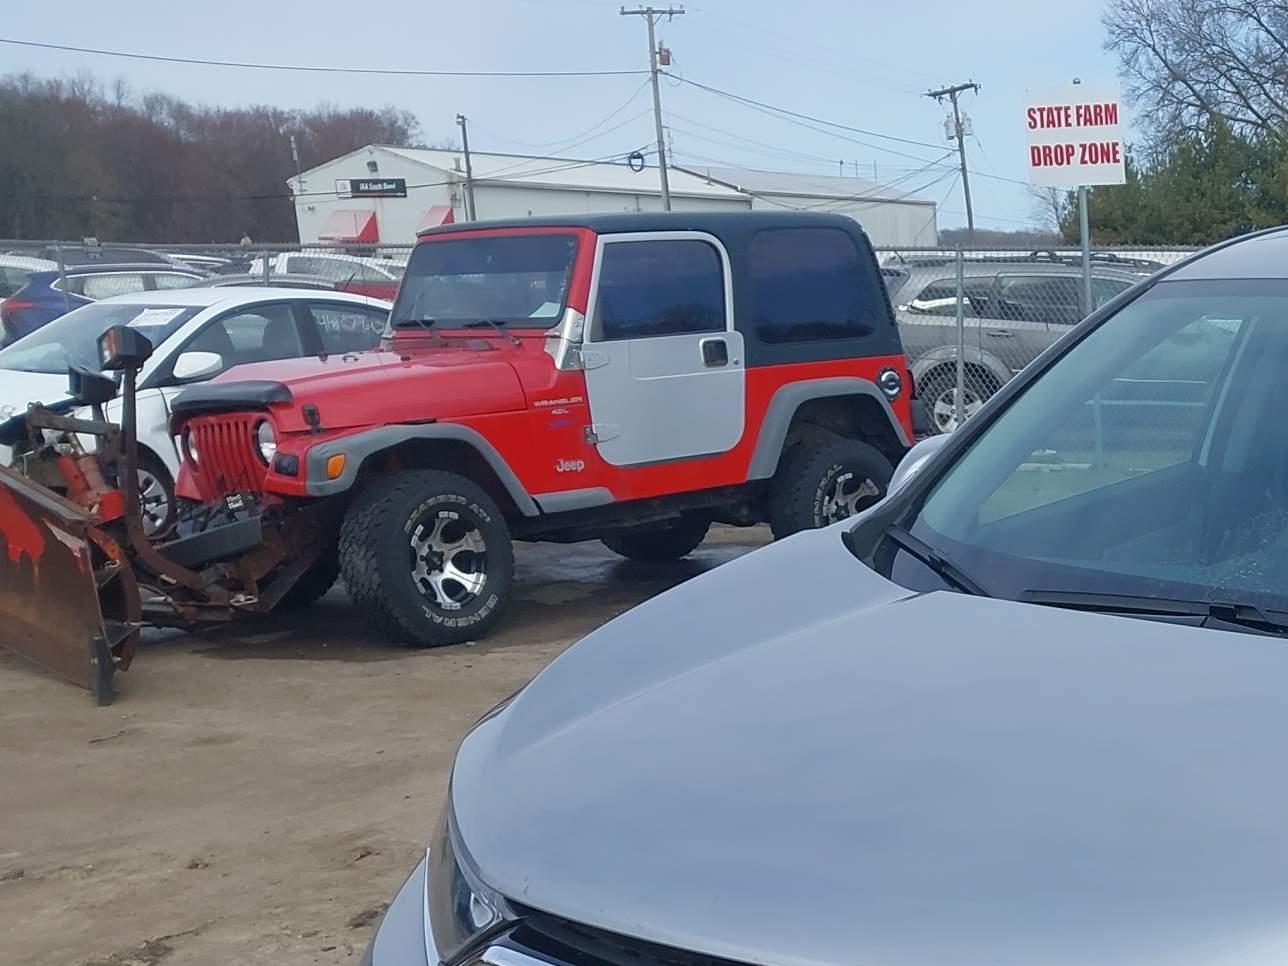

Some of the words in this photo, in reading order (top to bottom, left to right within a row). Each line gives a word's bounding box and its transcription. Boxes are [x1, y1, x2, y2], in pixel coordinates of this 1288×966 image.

[1027, 105, 1072, 129] STATE
[1075, 103, 1118, 127] FARM
[1030, 144, 1075, 167] DROP
[1079, 142, 1121, 165] ZONE
[554, 458, 585, 473] Jeep
